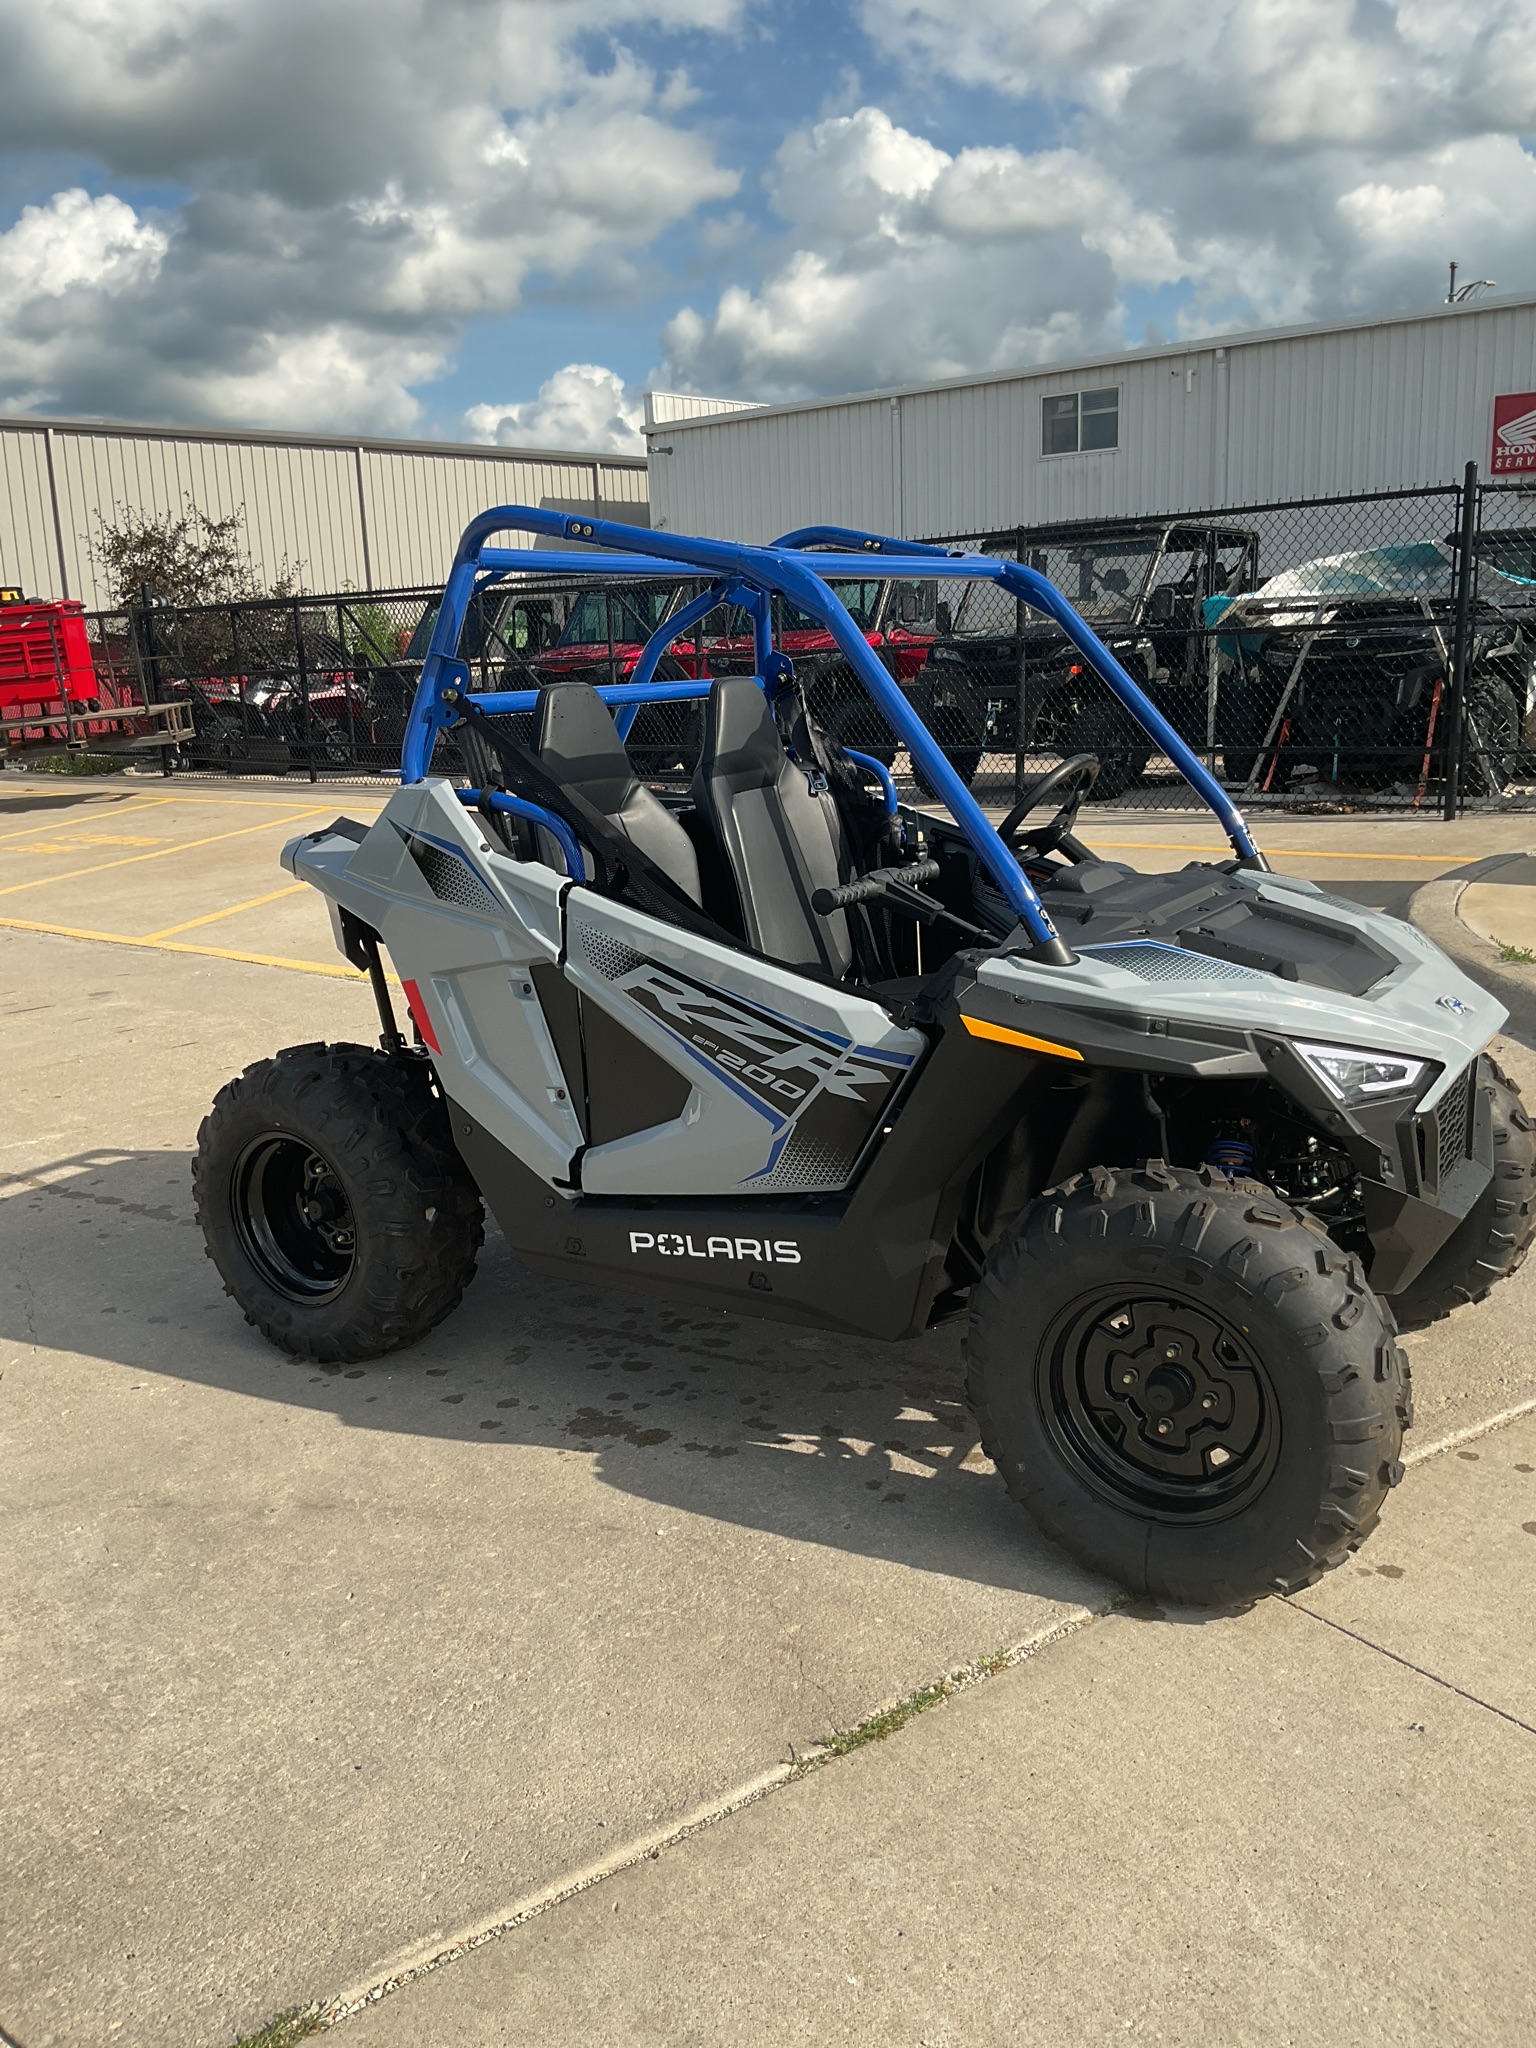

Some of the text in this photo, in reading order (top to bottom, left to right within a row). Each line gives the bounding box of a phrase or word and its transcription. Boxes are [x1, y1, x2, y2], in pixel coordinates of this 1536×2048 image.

[691, 1034, 806, 1099] EFI 200
[629, 1232, 801, 1264] POLARIS
